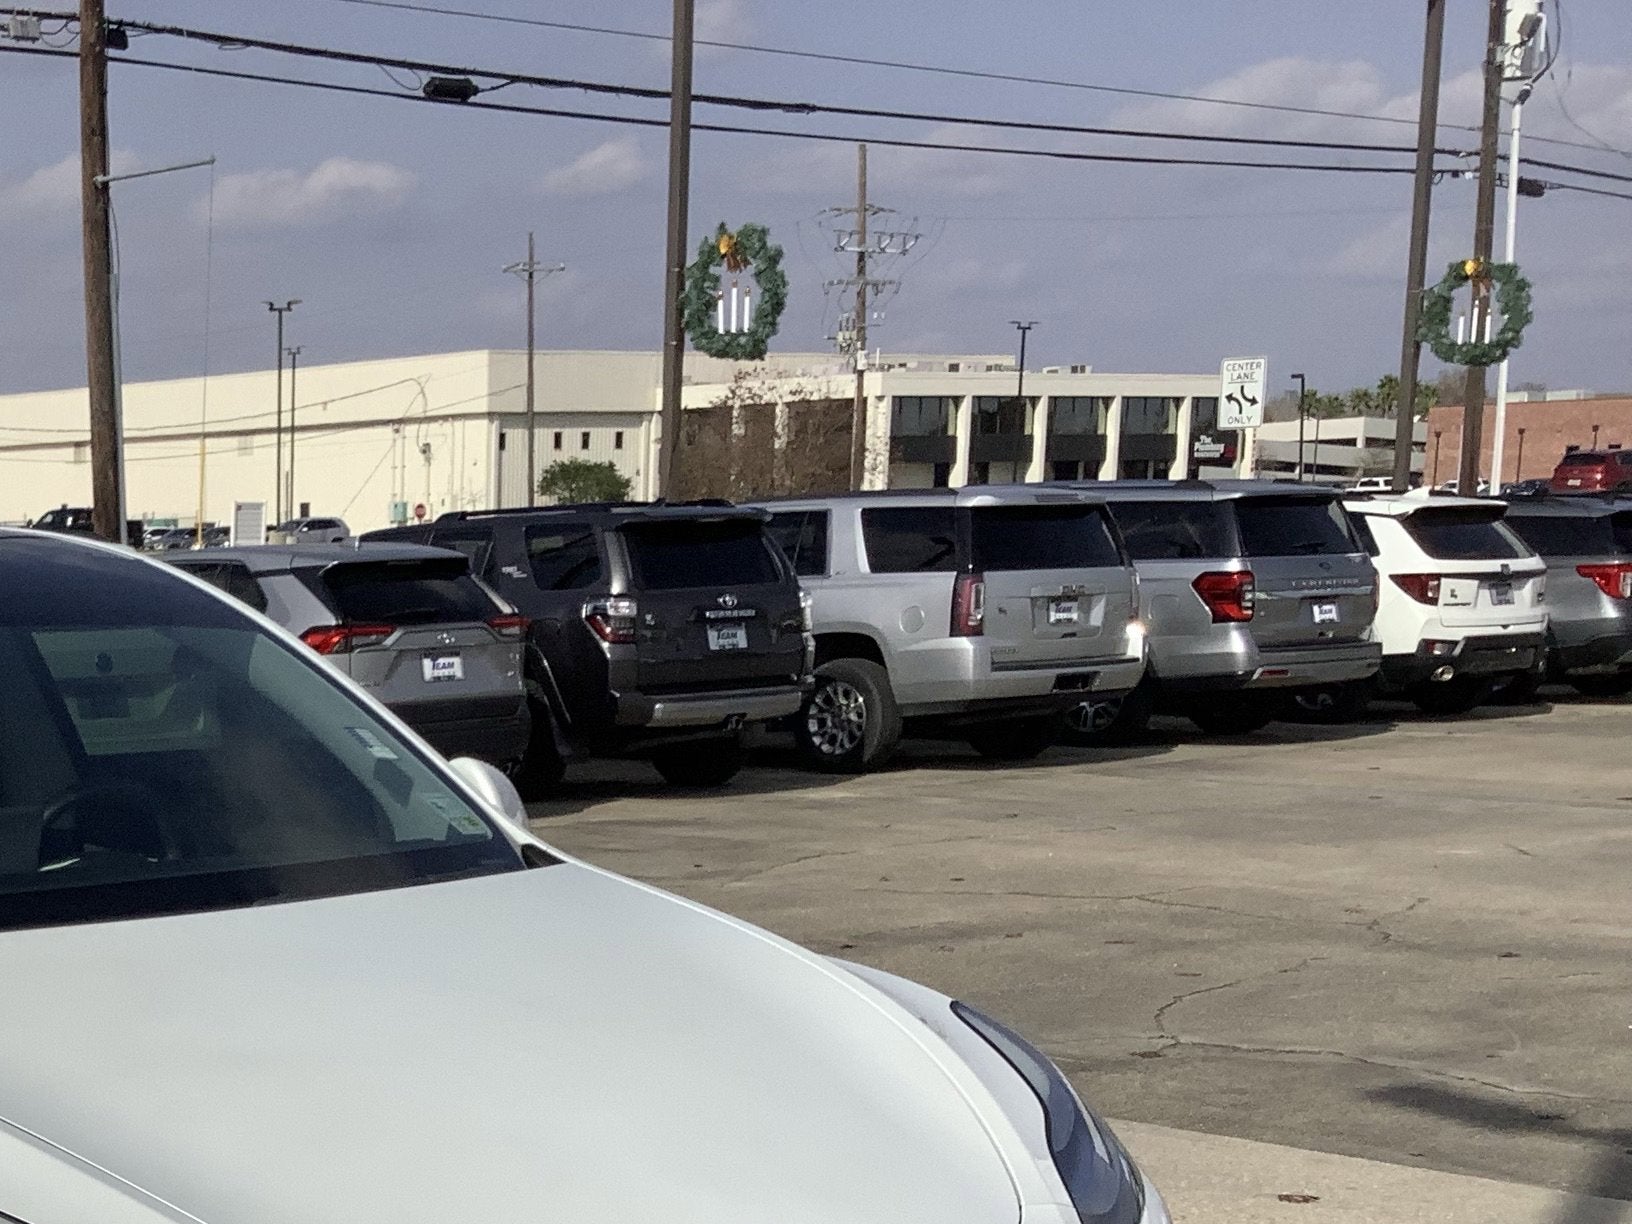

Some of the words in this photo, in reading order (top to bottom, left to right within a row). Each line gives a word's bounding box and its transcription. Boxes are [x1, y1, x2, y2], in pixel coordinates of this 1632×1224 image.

[1225, 361, 1262, 372] CENTER
[1230, 372, 1256, 381] LANE
[1227, 415, 1253, 425] ONLY
[431, 656, 455, 671] TEAM
